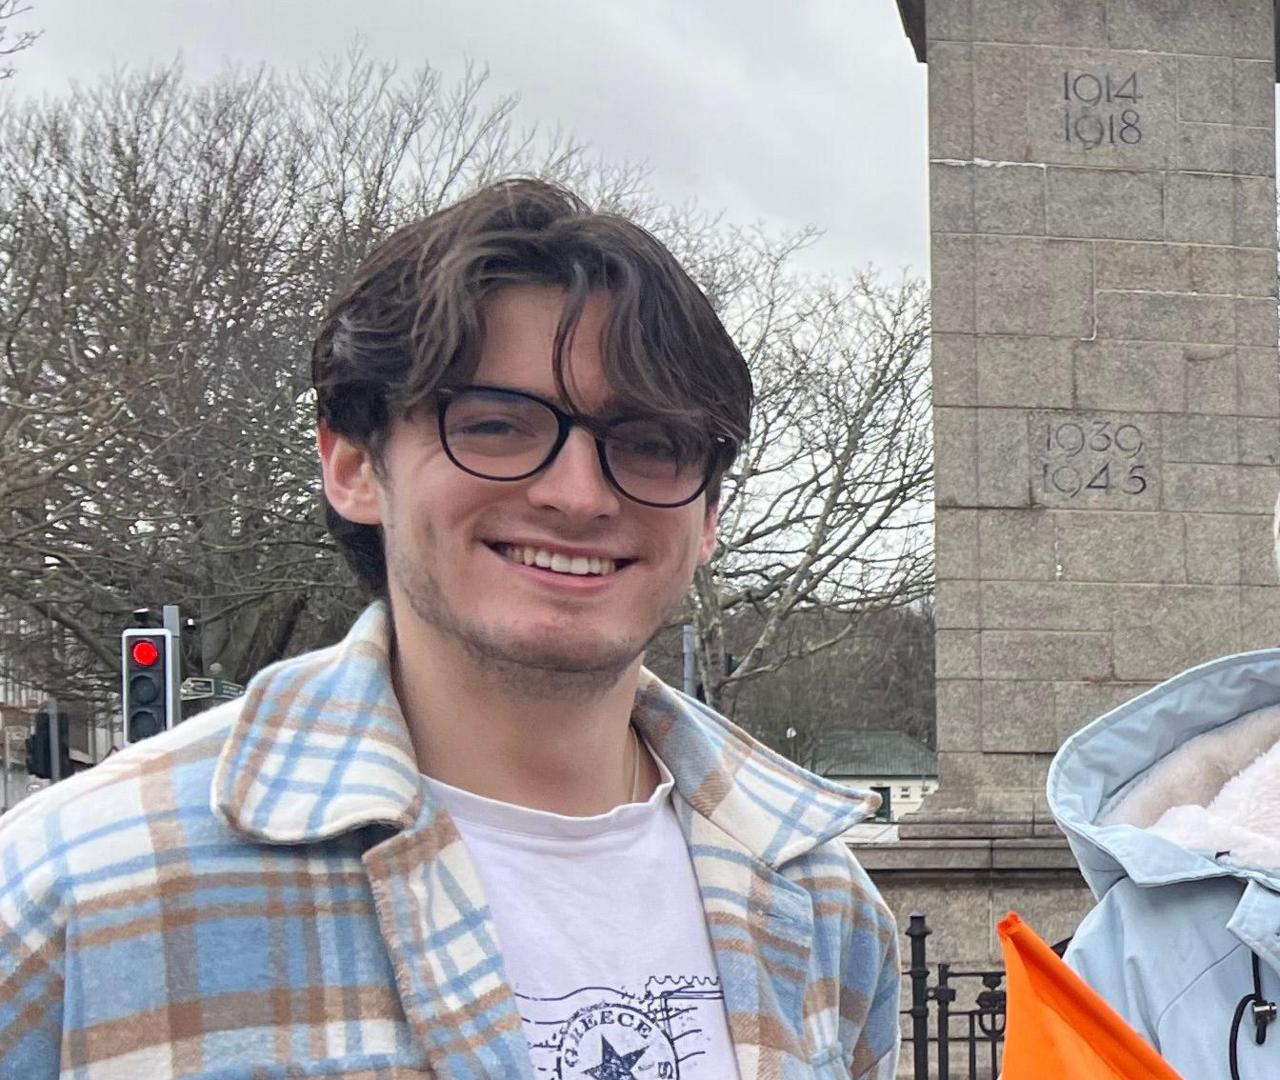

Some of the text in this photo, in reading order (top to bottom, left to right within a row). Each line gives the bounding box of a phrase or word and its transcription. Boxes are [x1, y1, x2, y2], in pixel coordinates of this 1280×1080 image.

[1062, 69, 1144, 106] 1914
[1062, 108, 1144, 150] 1918
[1044, 420, 1145, 459] 1939
[1041, 462, 1148, 498] 1945
